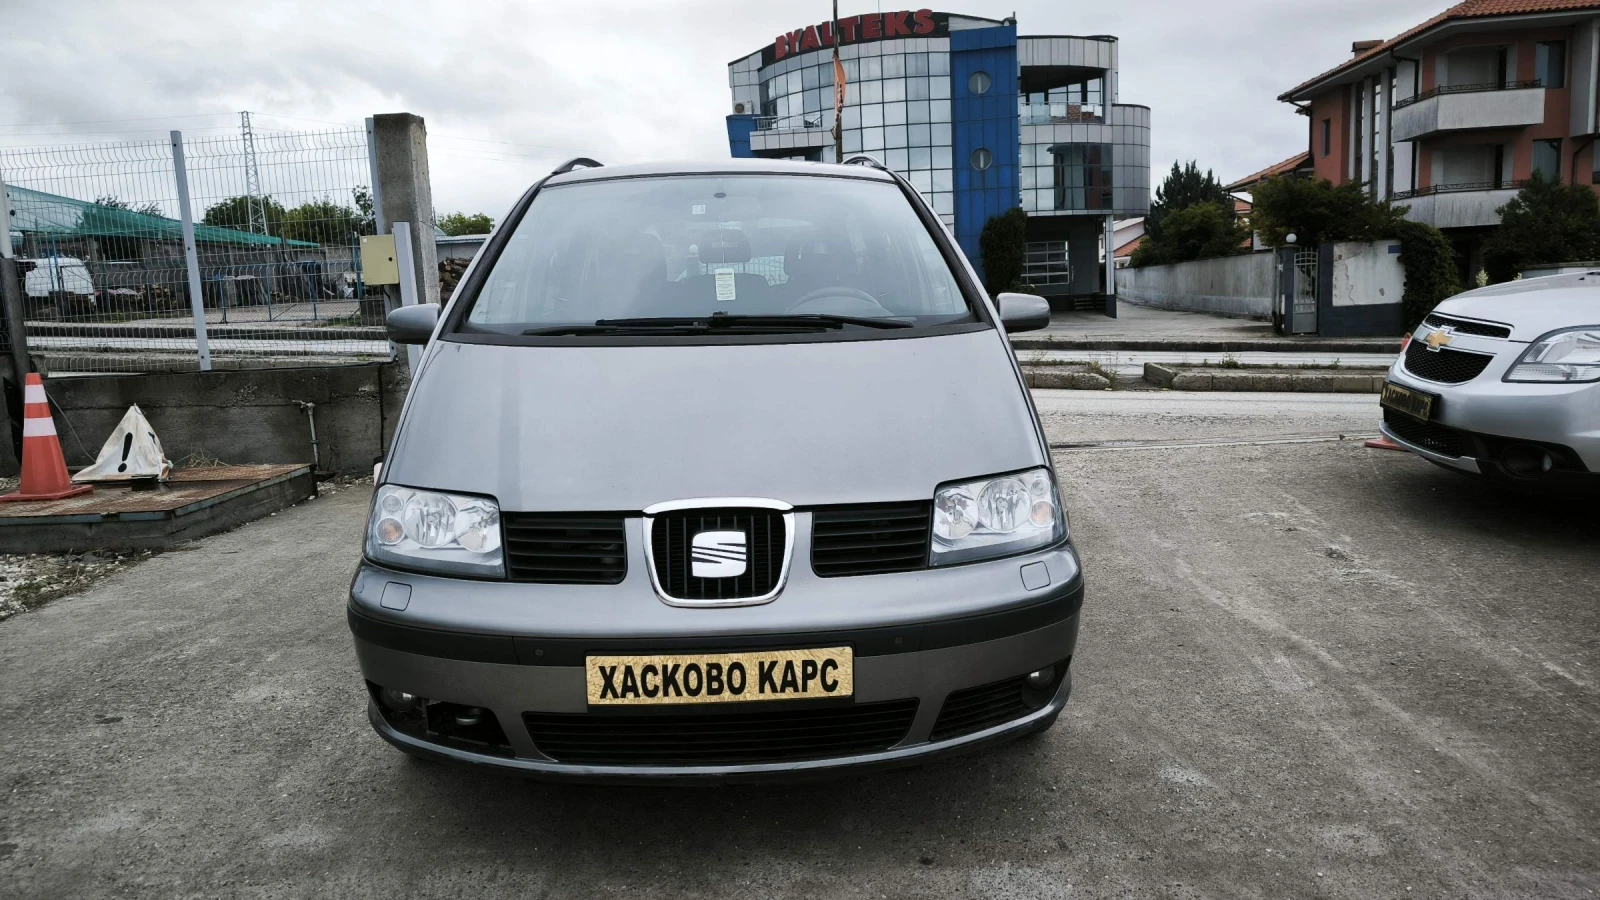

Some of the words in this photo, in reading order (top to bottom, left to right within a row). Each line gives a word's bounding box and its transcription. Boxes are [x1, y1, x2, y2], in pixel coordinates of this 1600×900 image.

[775, 9, 935, 60] BYALTEKS
[598, 663, 747, 699] ХАСКОВО
[758, 658, 839, 694] КАРС
